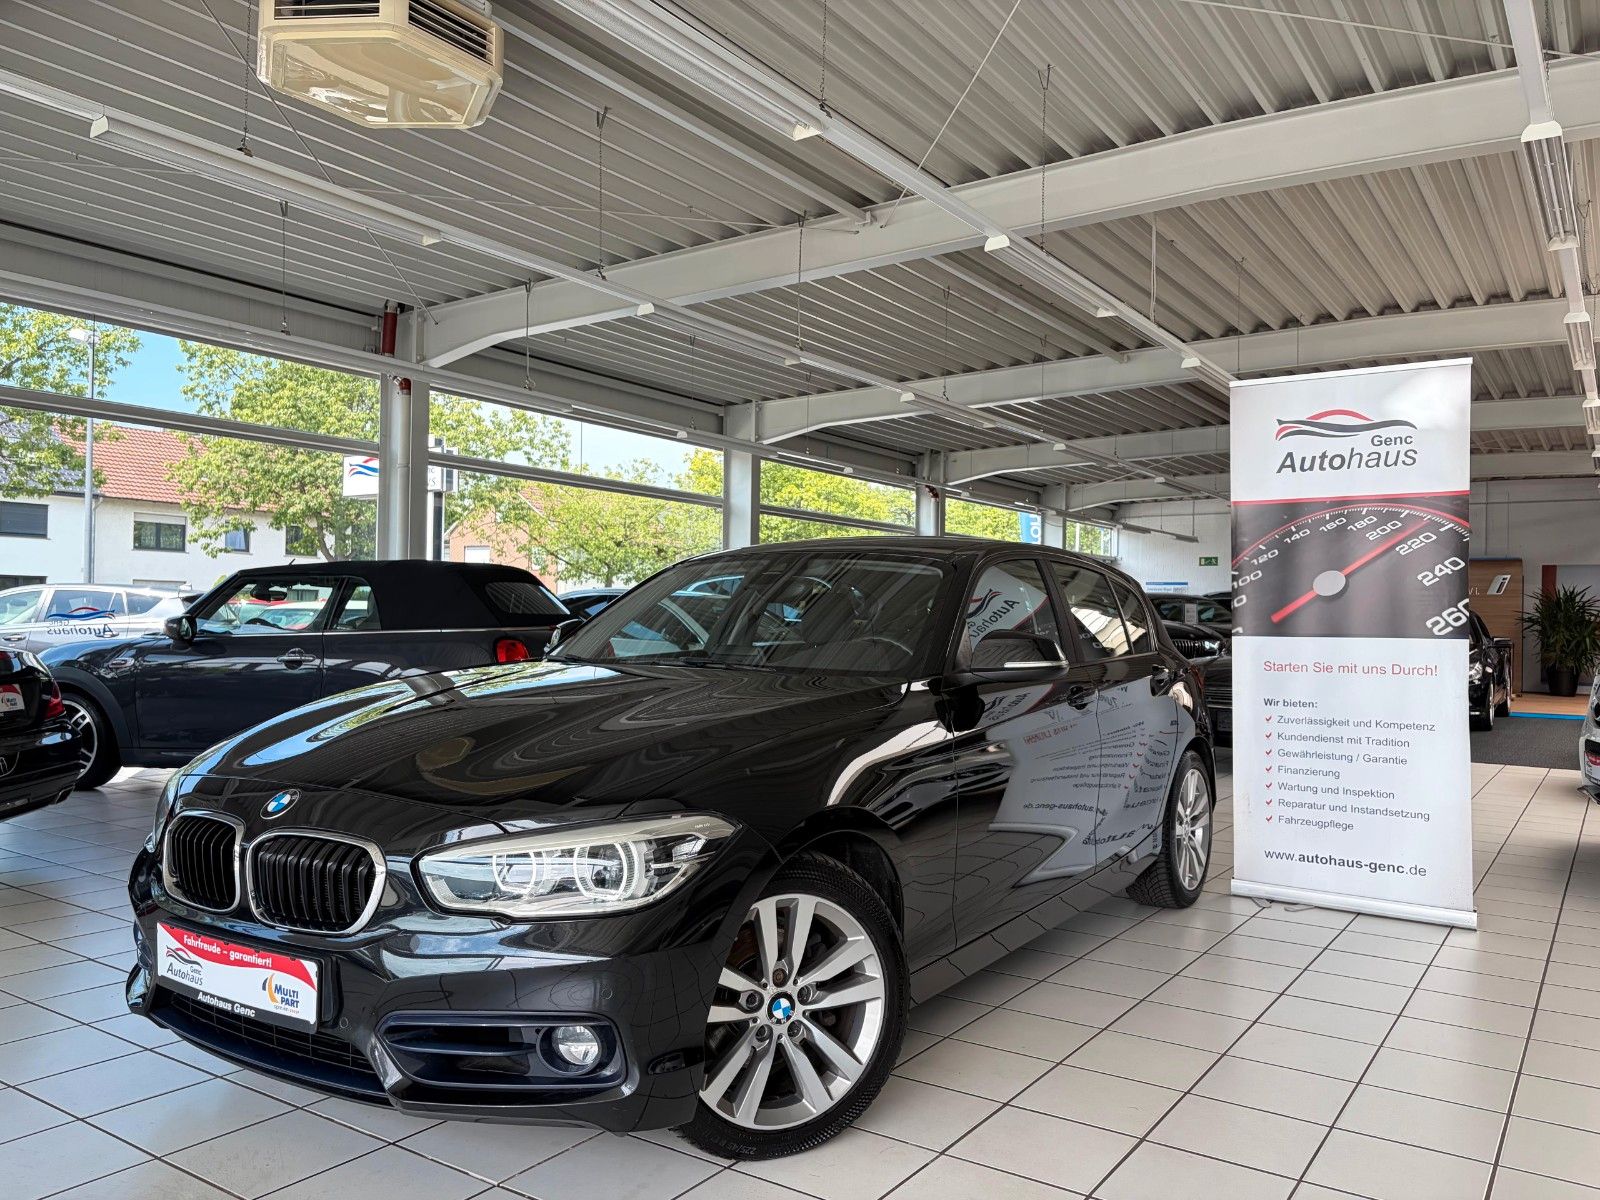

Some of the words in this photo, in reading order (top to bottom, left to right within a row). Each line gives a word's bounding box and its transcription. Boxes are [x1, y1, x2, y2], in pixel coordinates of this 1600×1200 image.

[1370, 434, 1413, 447] Genc
[1276, 447, 1418, 474] Autohaus
[1319, 516, 1347, 532] 160
[1347, 515, 1378, 532] 180
[1365, 520, 1402, 541] 200
[1284, 528, 1311, 544] 140
[1395, 531, 1437, 556] 220
[1251, 549, 1279, 565] 120
[1416, 556, 1466, 587] 240
[1264, 661, 1308, 673] Starten
[1313, 662, 1334, 673] Sie
[1338, 663, 1358, 674] mit
[1362, 665, 1387, 675] uns
[1391, 664, 1438, 677] Durch!
[1264, 698, 1280, 707] Wir
[1282, 699, 1318, 709] bieten:
[1277, 715, 1350, 728] Zuverlässigkeit
[1353, 719, 1372, 728] und
[1375, 720, 1436, 732] Kompetenz
[1277, 732, 1344, 744] Kundendienst
[1347, 735, 1362, 745] mit
[1365, 736, 1410, 748] Tradition
[1277, 748, 1353, 763] Gewährleistung
[1355, 753, 1360, 762] /
[1362, 753, 1408, 765] Garantie
[1277, 765, 1340, 780] Finanzierung
[1277, 781, 1318, 795] Wartung
[1321, 786, 1339, 795] und
[1342, 787, 1395, 799] Inspektion
[1278, 798, 1326, 810] Reparatur
[1328, 804, 1348, 813] und
[1350, 804, 1430, 822] Instandsetzung
[1278, 815, 1354, 831] Fahrzeugpflege
[1264, 849, 1427, 877] www.autohaus-genc.de
[183, 934, 221, 954] Fahrfreude
[229, 950, 272, 968] garantiert!
[166, 962, 203, 987] Autohaus
[190, 965, 202, 976] Genc
[274, 983, 299, 999] MULTI
[198, 991, 232, 1011] Autohaus
[233, 1003, 256, 1017] Genc
[280, 996, 300, 1009] PART
